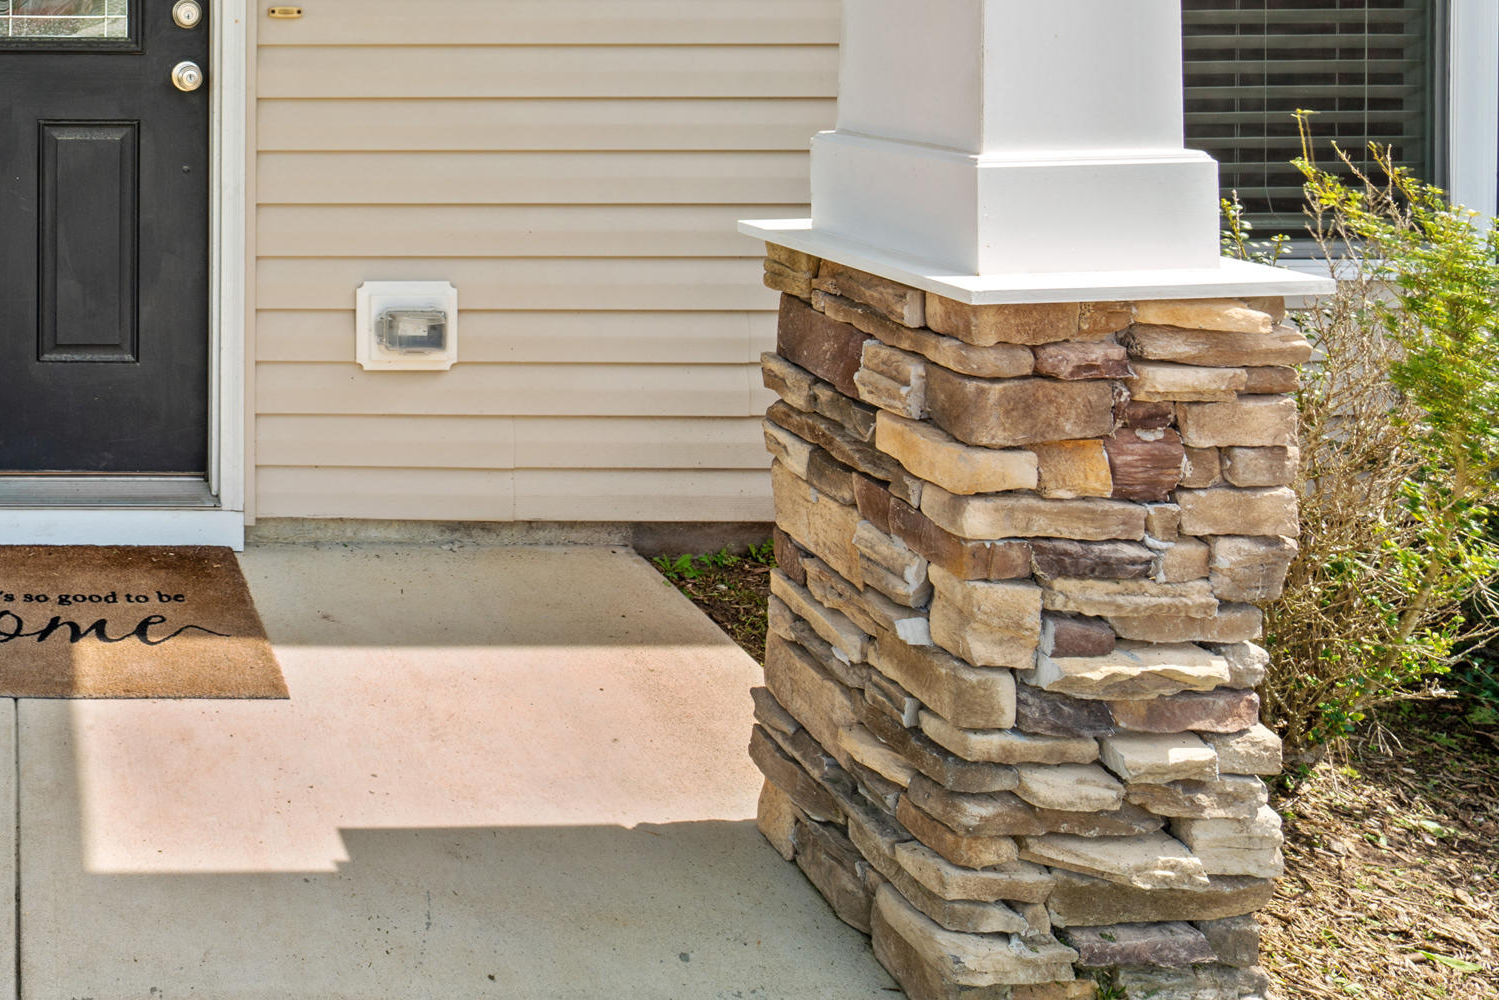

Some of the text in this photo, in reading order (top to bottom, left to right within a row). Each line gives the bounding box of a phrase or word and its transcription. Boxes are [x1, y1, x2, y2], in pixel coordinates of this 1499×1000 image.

[23, 593, 50, 603] so
[57, 591, 118, 606] good
[124, 593, 149, 604] to
[156, 591, 186, 603] be
